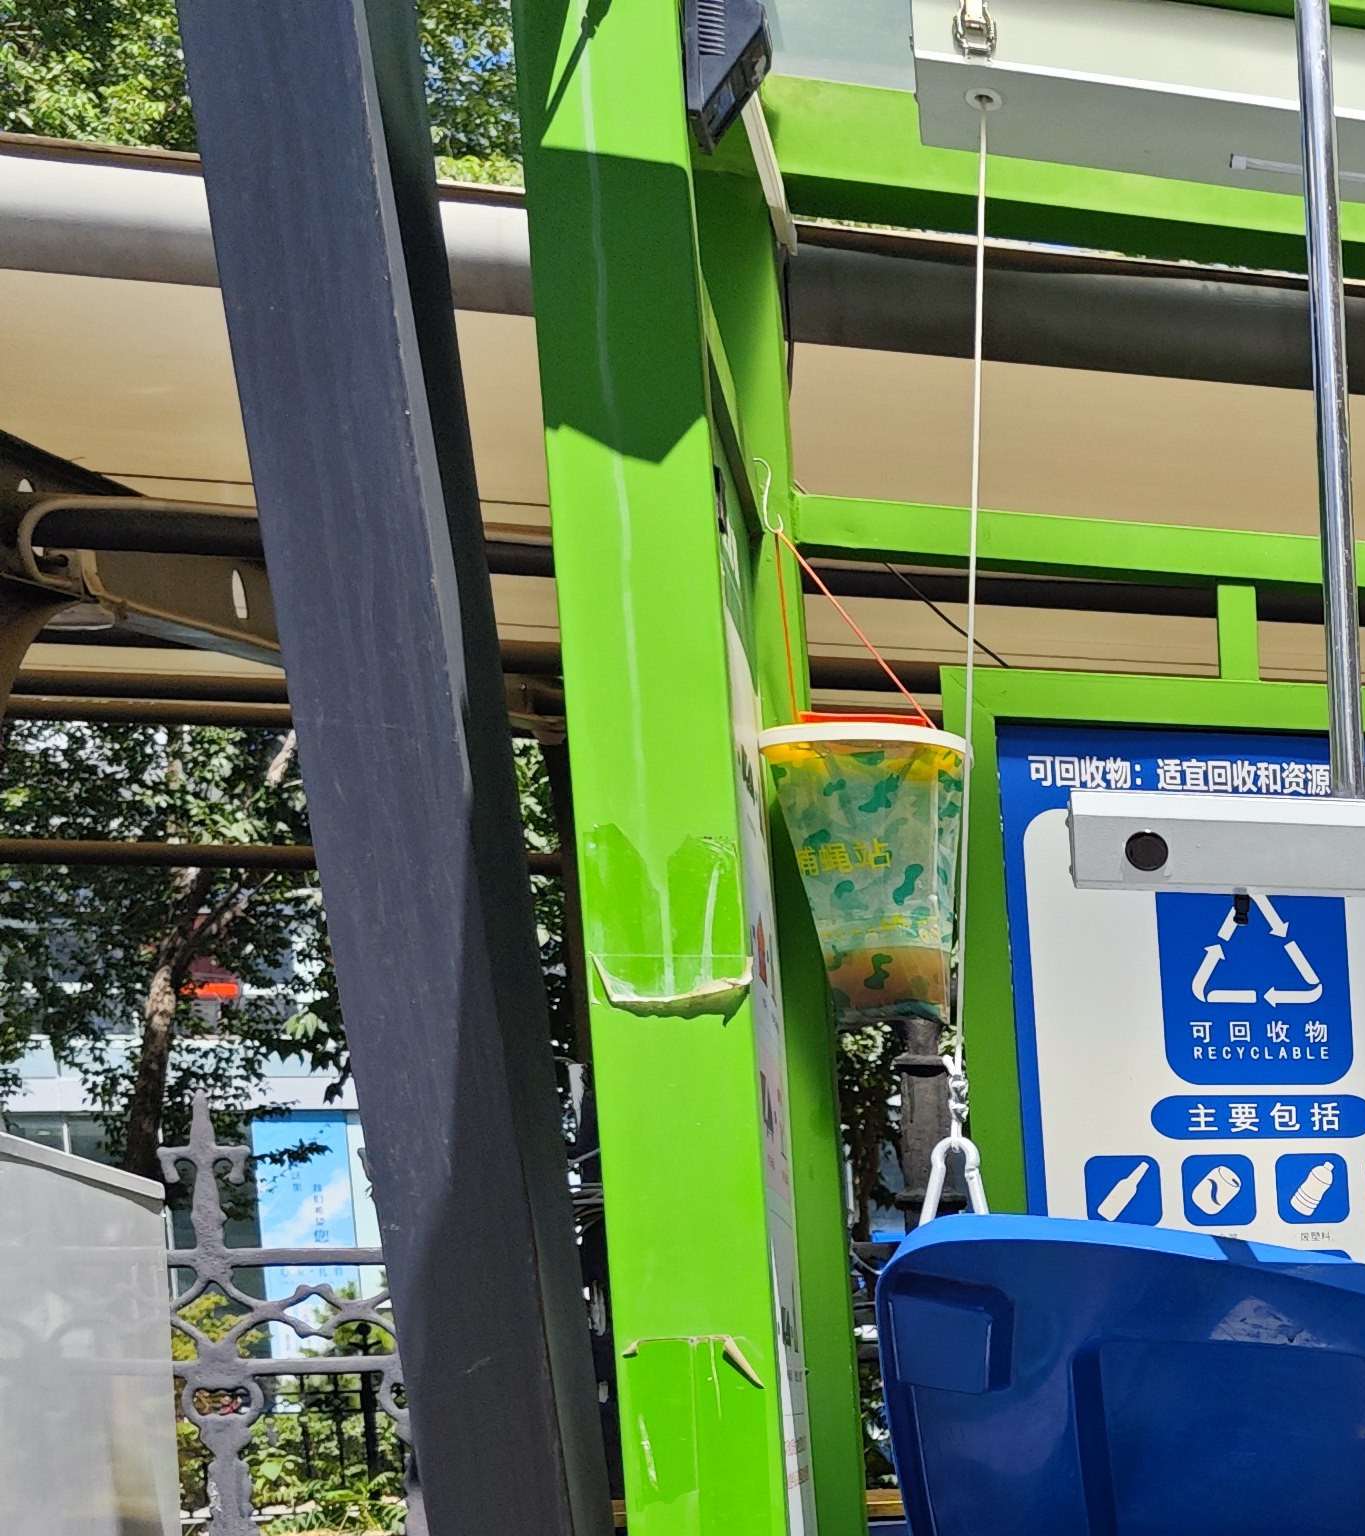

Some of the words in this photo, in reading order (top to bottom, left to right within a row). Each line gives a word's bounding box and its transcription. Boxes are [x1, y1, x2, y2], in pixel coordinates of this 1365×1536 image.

[1190, 1021, 1328, 1043] 可回收物
[1193, 1046, 1329, 1060] RECYCLABLE
[1188, 1102, 1340, 1132] 主要包括
